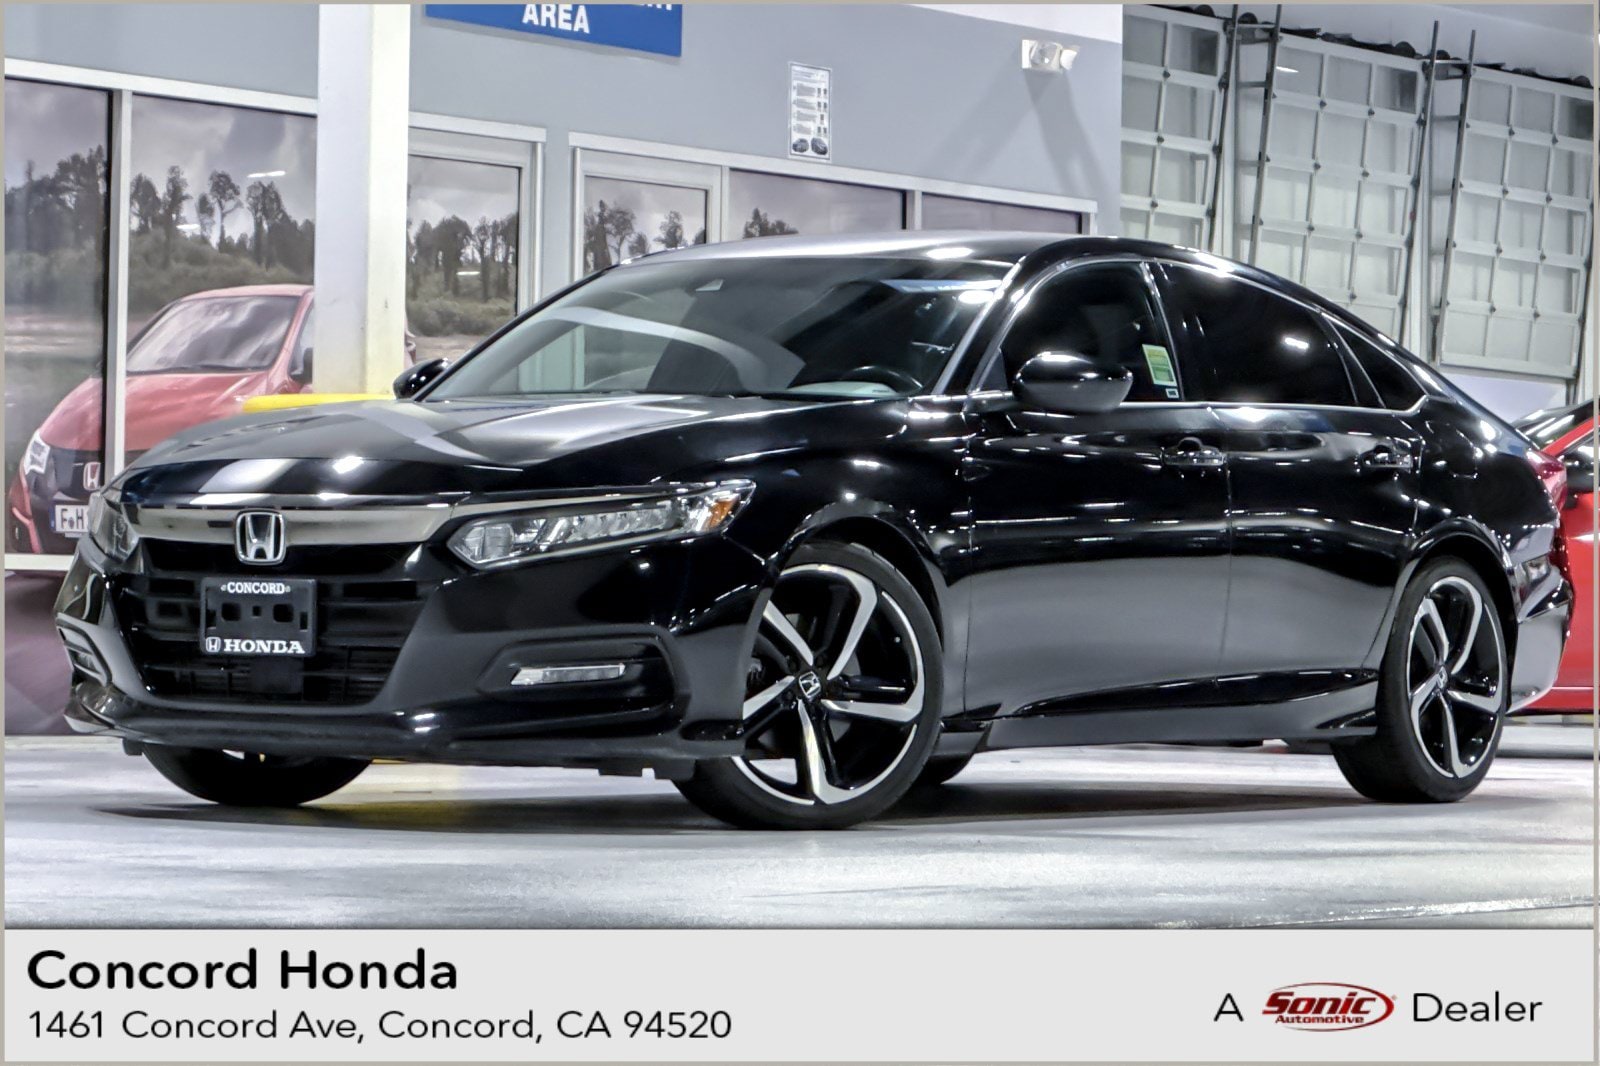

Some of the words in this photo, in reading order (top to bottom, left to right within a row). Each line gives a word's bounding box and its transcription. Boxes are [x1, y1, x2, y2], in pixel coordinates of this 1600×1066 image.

[522, 4, 590, 34] AREA
[227, 582, 285, 594] CONCORD
[223, 638, 306, 654] HONDA
